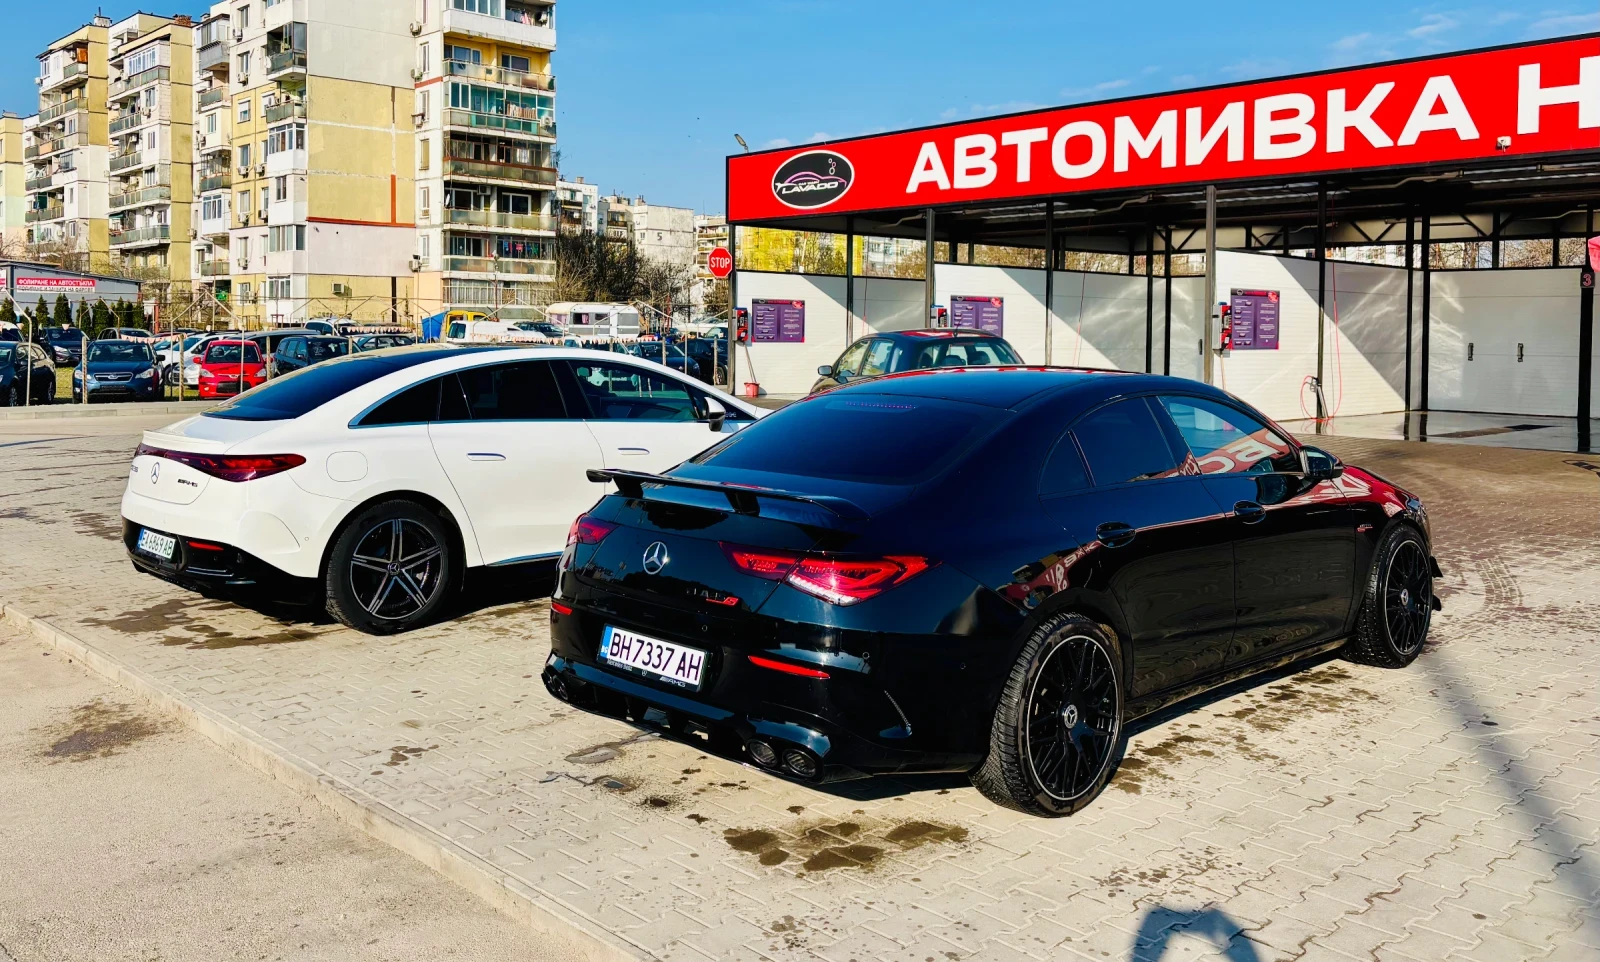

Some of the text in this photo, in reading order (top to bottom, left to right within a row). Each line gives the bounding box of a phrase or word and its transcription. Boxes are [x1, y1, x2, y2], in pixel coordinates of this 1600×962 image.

[905, 75, 1480, 194] АВТОМИВКА
[782, 181, 838, 194] LAVADO
[656, 232, 663, 241] 5
[710, 257, 731, 269] STOP
[1583, 273, 1592, 287] 3
